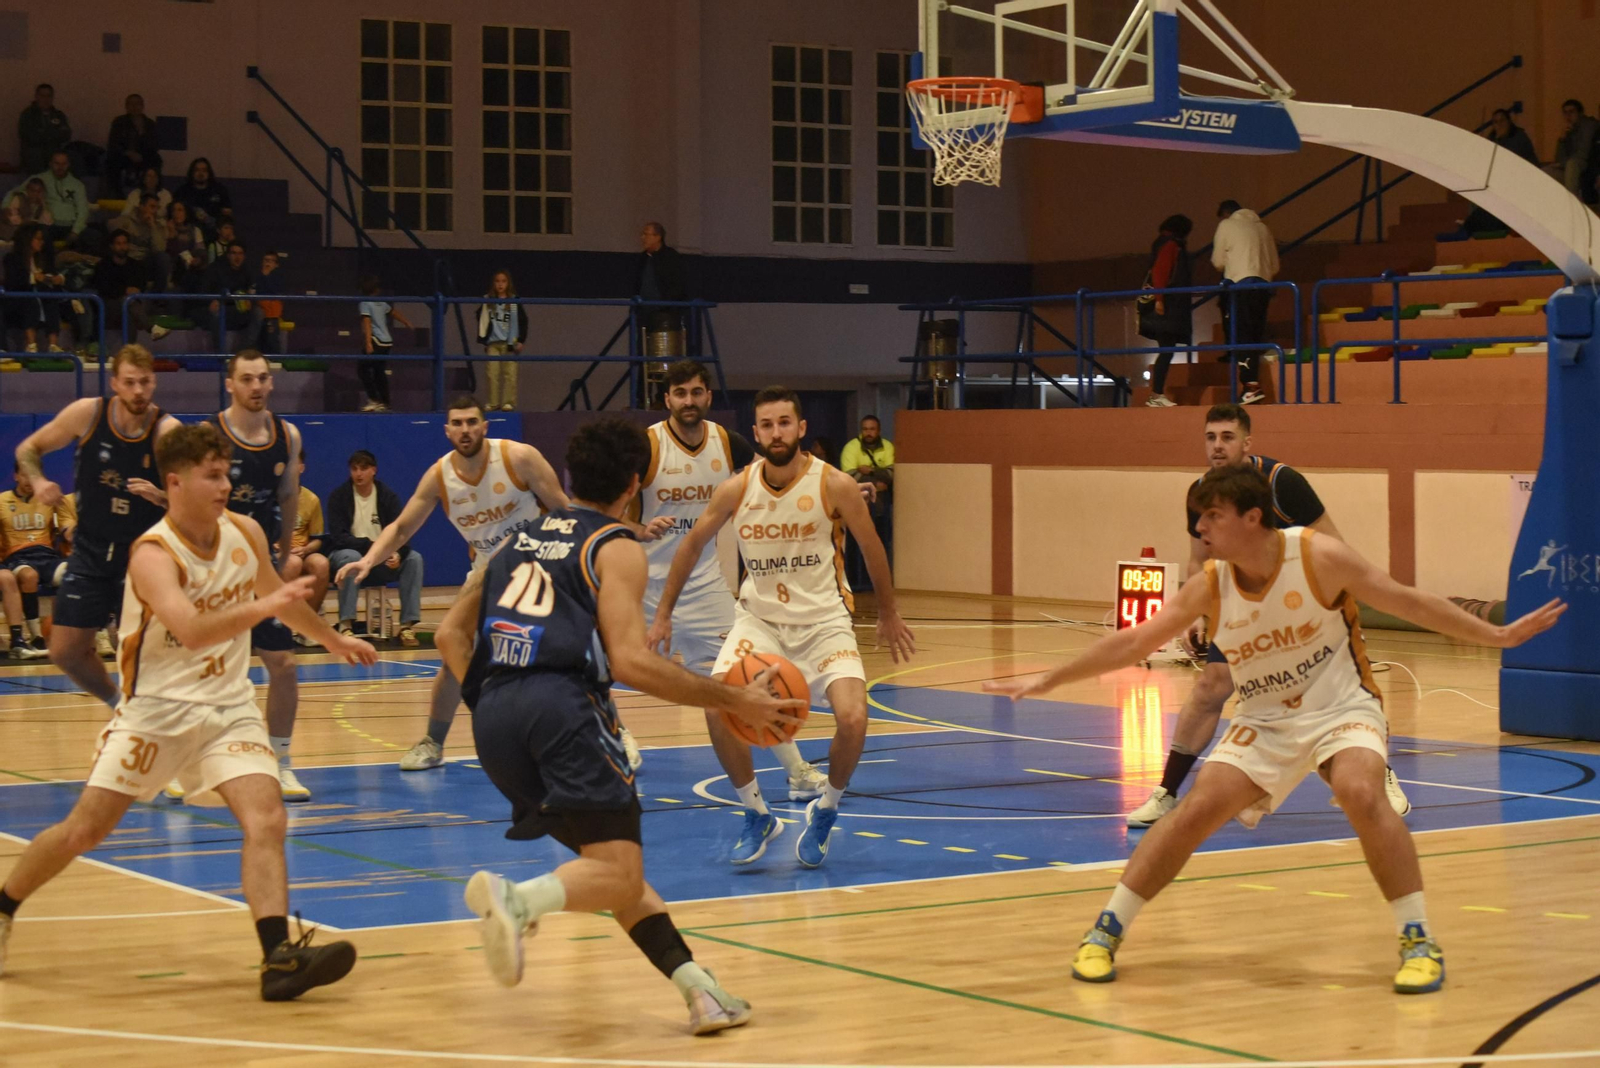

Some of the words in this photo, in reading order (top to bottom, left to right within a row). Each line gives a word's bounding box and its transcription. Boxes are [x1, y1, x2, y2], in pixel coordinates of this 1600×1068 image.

[657, 484, 713, 502] CBCM
[111, 498, 130, 515] 15
[457, 506, 504, 527] CBCM
[13, 513, 45, 531] ULB
[739, 523, 799, 540] CBCM
[791, 554, 821, 567] OLEA
[497, 561, 555, 617] 10
[1122, 569, 1163, 592] 09:28
[776, 583, 791, 604] 8
[1223, 626, 1296, 666] CBCM
[816, 649, 850, 673] CBCM
[1296, 645, 1333, 675] OLEA
[1220, 724, 1258, 747] 10
[120, 736, 159, 775] 30
